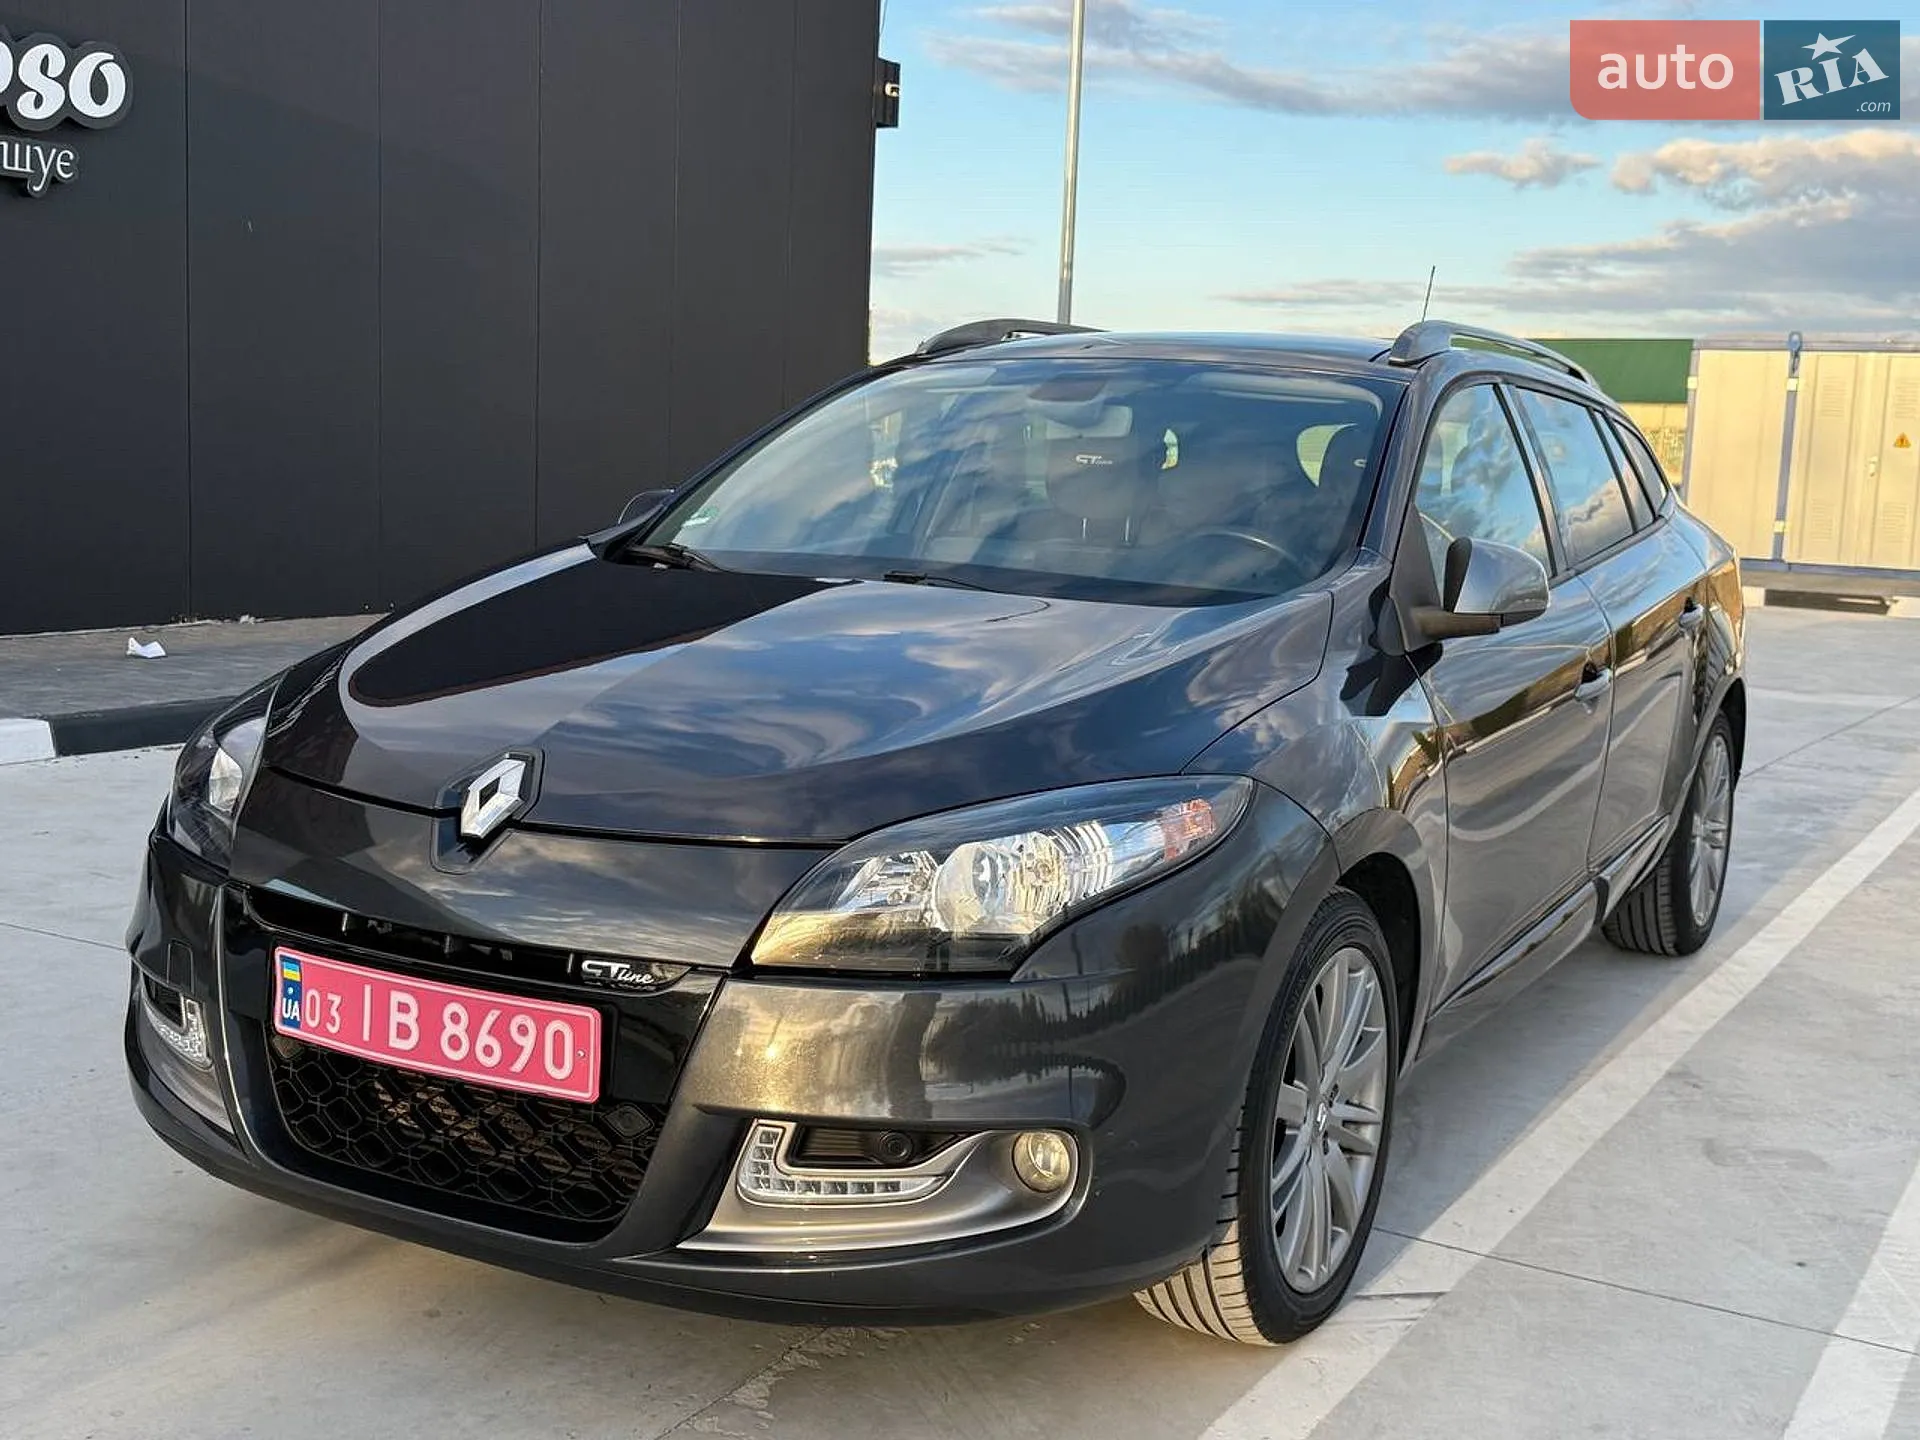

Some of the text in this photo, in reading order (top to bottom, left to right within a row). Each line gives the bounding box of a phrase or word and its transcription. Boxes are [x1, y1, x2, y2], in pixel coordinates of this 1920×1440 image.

[0, 41, 126, 120] so
[282, 997, 300, 1021] UA
[305, 988, 342, 1034] 03
[440, 1001, 575, 1081] 8690
